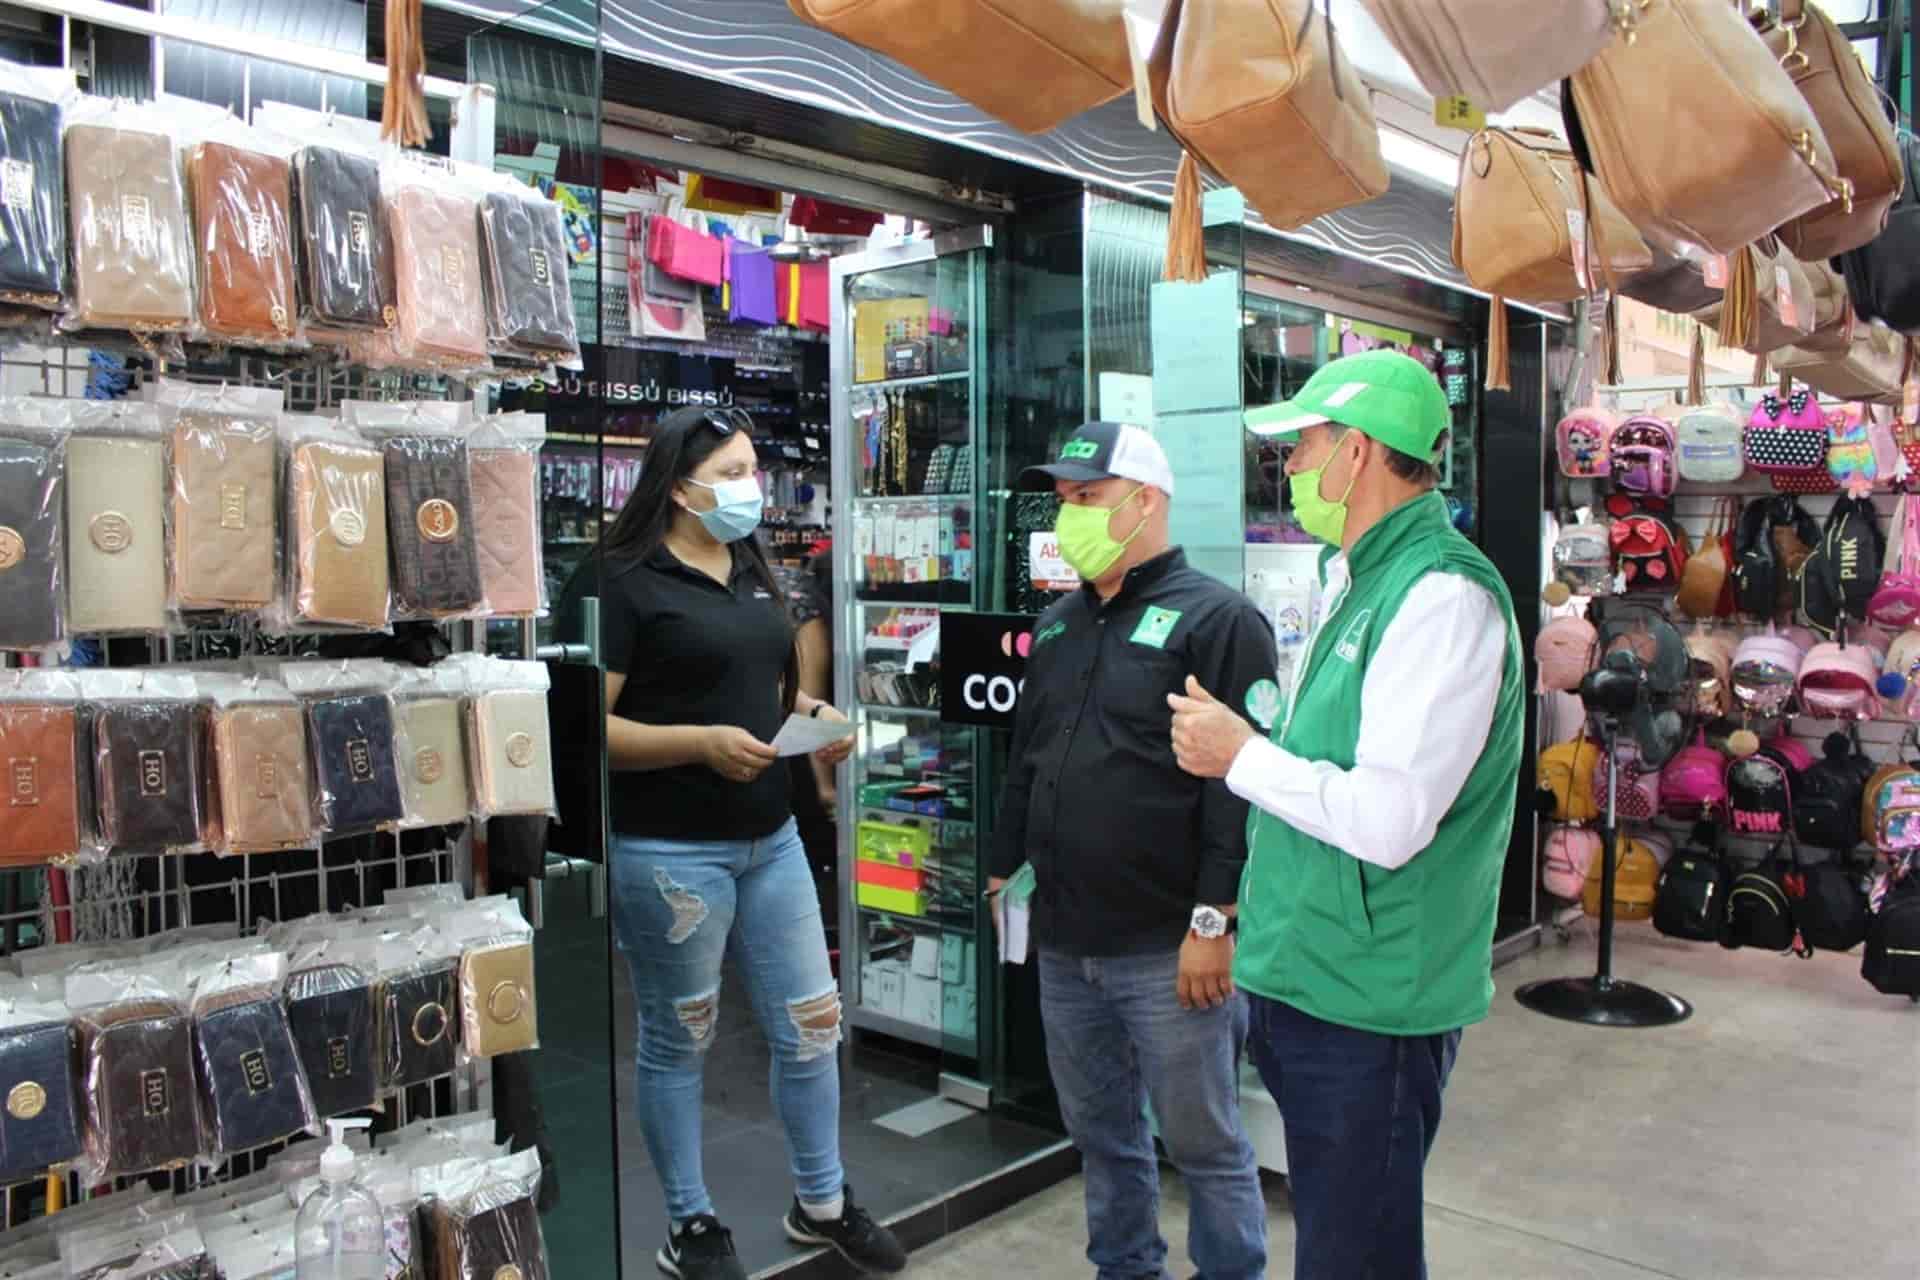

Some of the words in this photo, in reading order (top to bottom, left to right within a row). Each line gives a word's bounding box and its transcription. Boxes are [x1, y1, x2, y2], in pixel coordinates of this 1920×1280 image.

[667, 385, 733, 407] BISSÚ
[1840, 537, 1858, 579] PINK
[145, 760, 160, 787] HO
[352, 749, 368, 773] HO
[1733, 808, 1782, 832] PINK
[331, 1043, 346, 1072] HO
[247, 1058, 265, 1085] HO
[147, 1079, 162, 1106] HO
